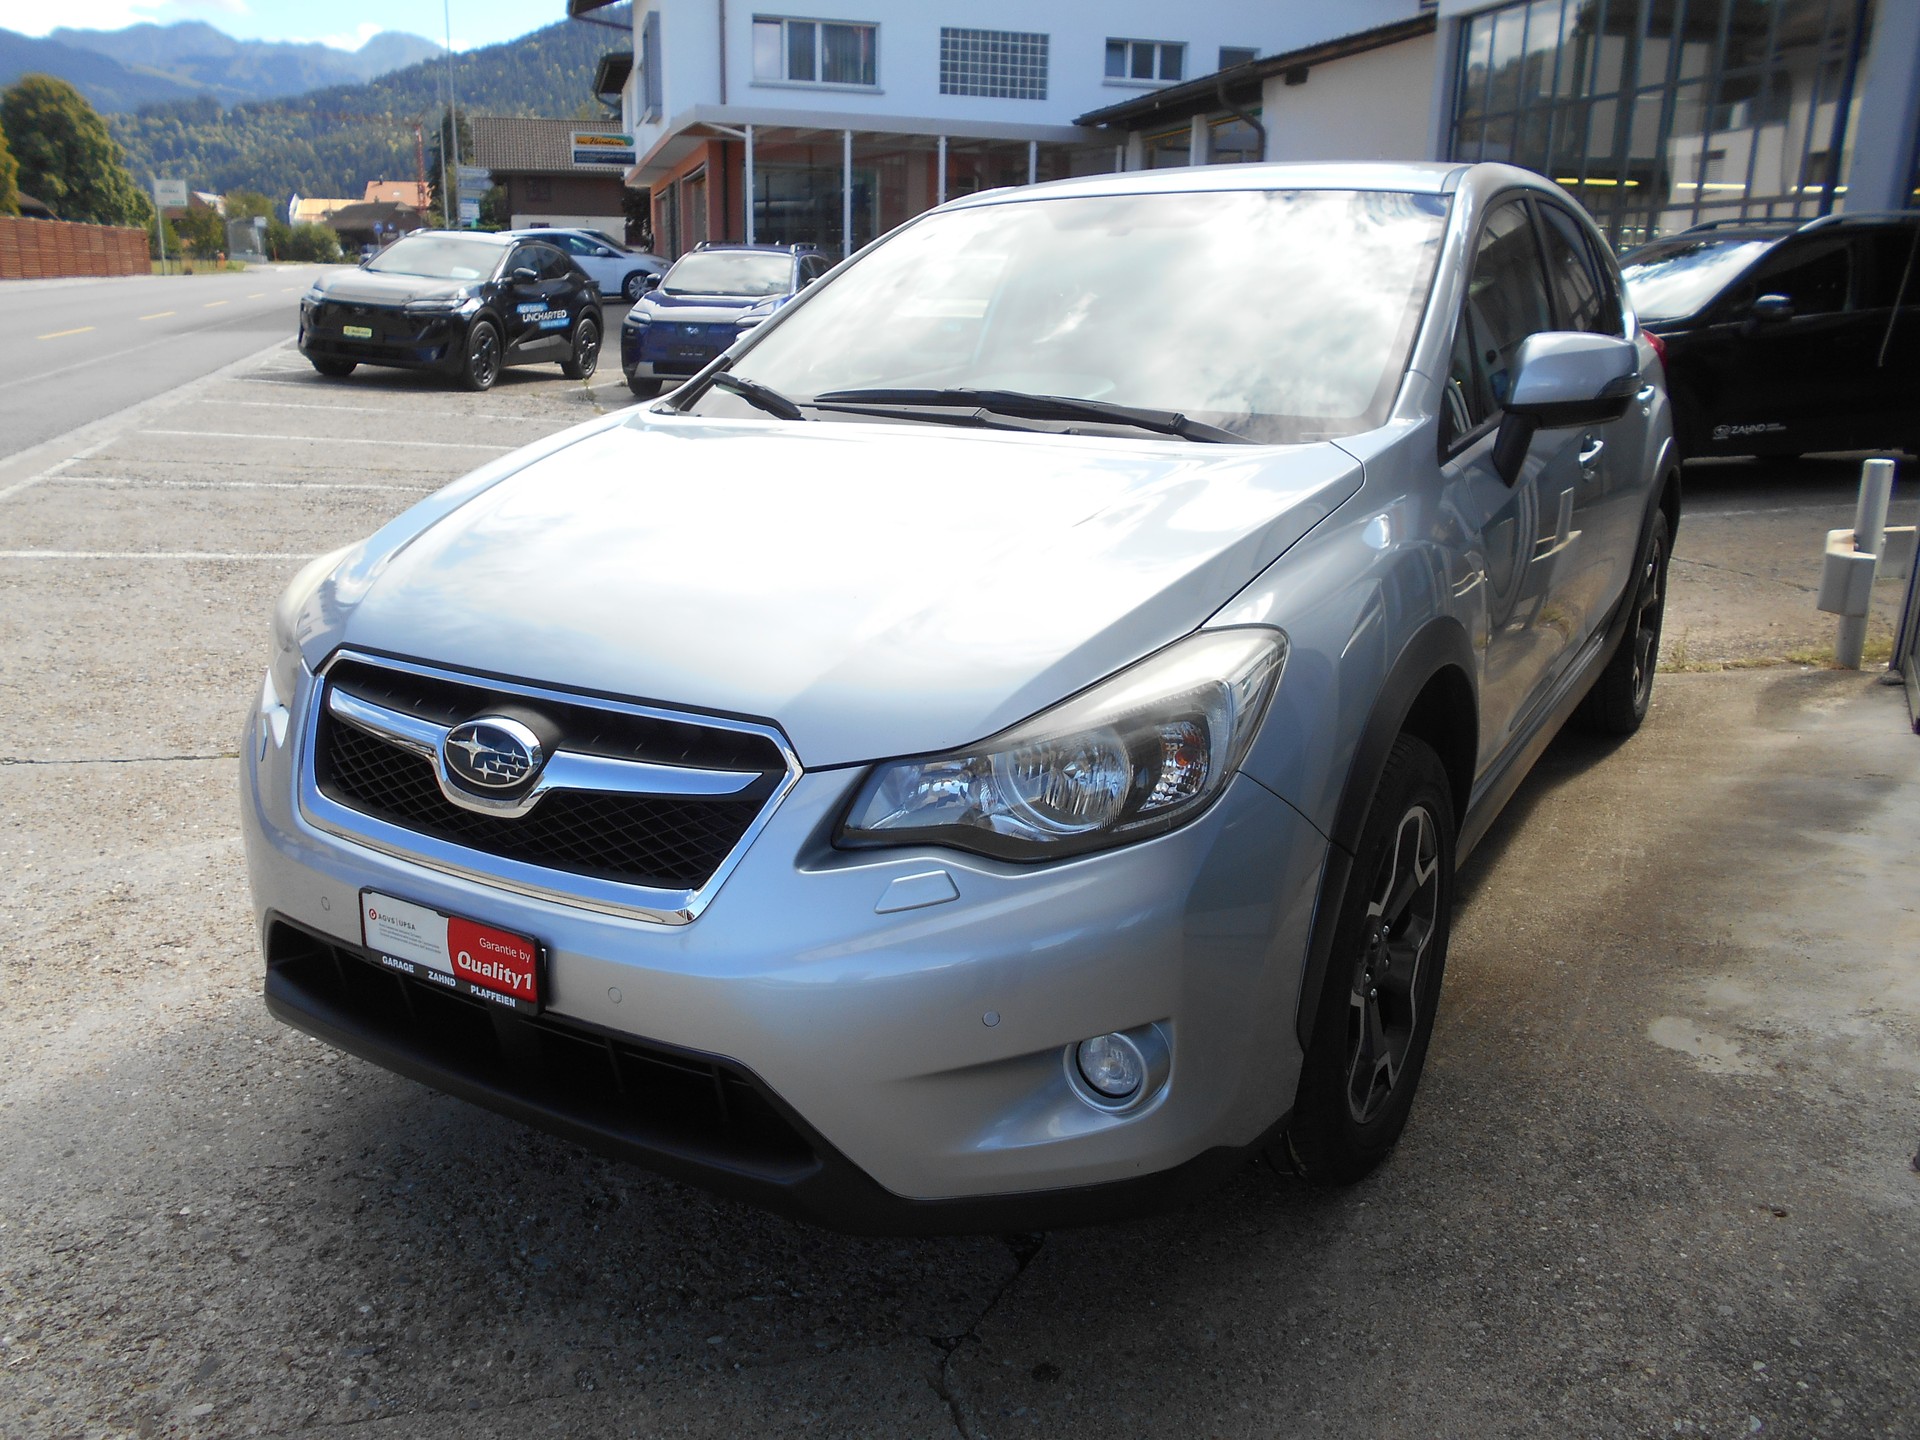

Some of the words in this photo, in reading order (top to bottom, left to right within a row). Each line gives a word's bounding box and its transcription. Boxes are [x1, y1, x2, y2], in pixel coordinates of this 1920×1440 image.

[522, 309, 567, 322] UNCHARTED
[1731, 423, 1766, 434] ZAHND
[479, 937, 517, 958] Garantie
[519, 950, 531, 963] by
[382, 955, 414, 974] GARAGE
[428, 970, 456, 987] ZAHND
[470, 984, 516, 1008] PLAFFEIEN
[457, 950, 533, 990] Quality1
